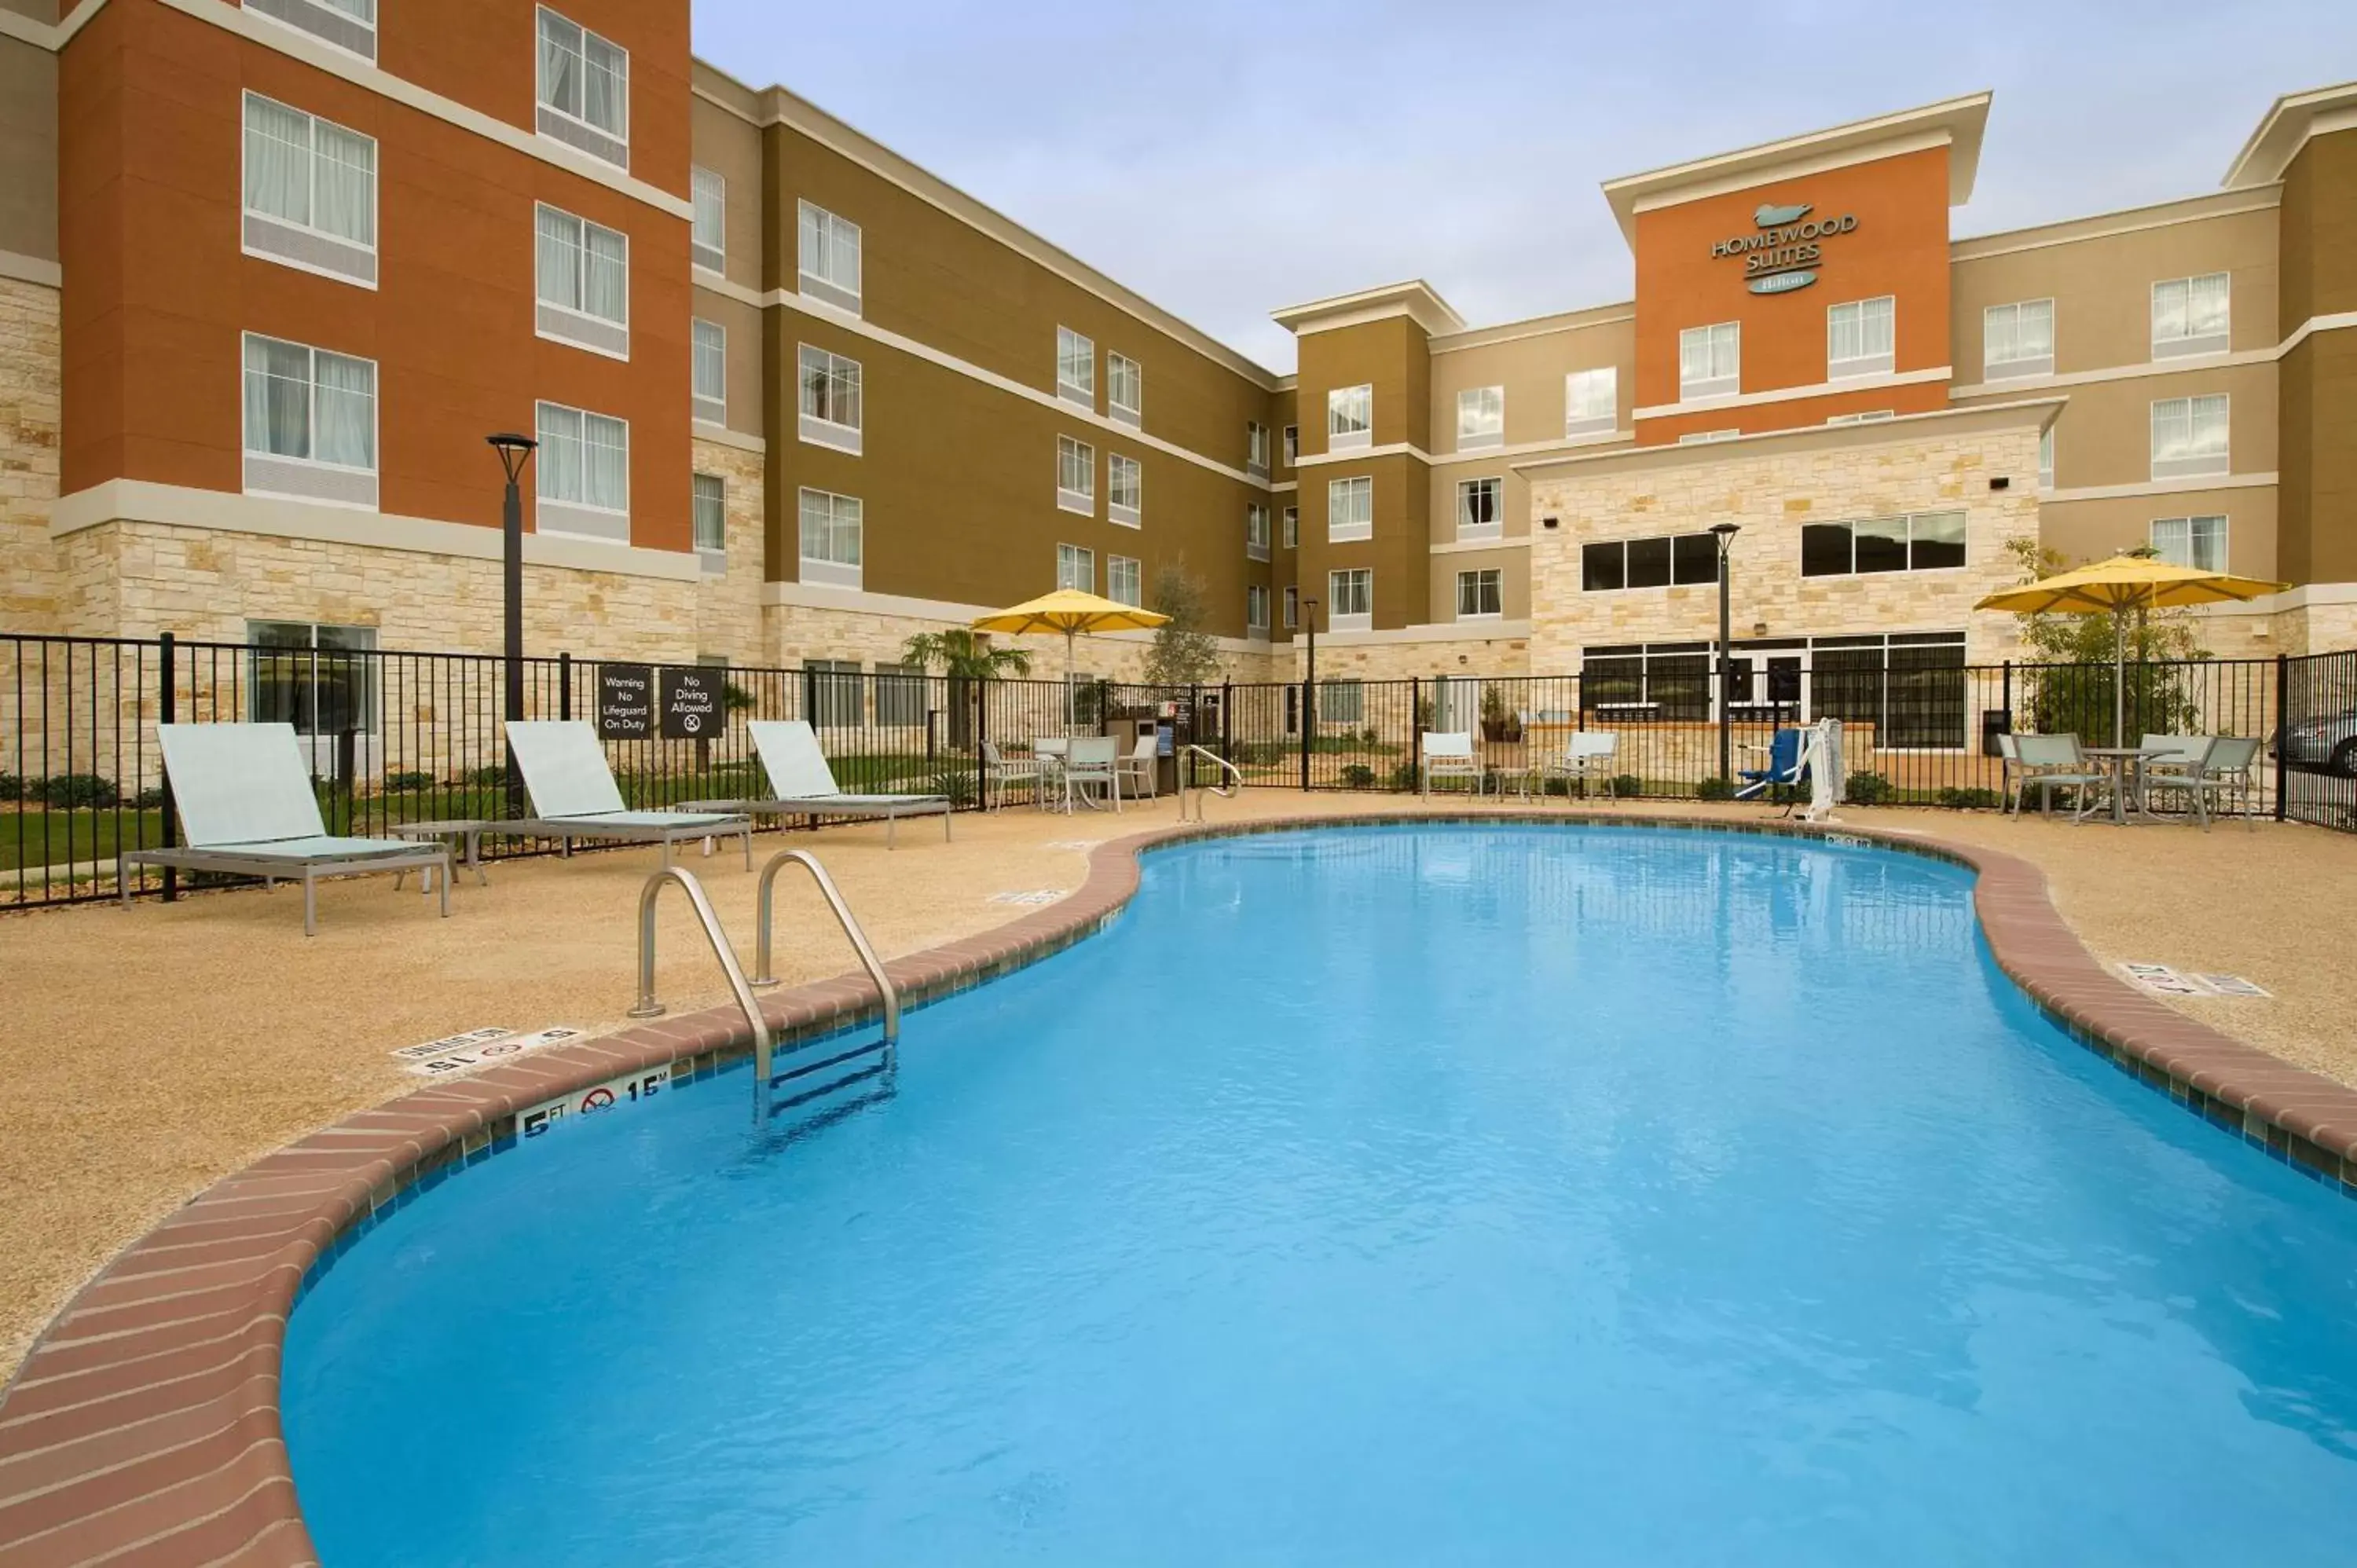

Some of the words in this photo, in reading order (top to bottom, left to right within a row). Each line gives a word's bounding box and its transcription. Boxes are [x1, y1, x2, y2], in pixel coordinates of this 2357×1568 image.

[1711, 214, 1860, 258] HOMEWOOD
[1746, 244, 1820, 271] SUITES
[604, 677, 645, 689] Warning
[684, 676, 700, 687] No
[618, 691, 632, 702] No
[675, 689, 708, 702] Diving
[603, 705, 647, 717] Lifeguard
[671, 702, 713, 713] Allowed
[604, 719, 620, 730] On
[623, 719, 645, 731] Duty
